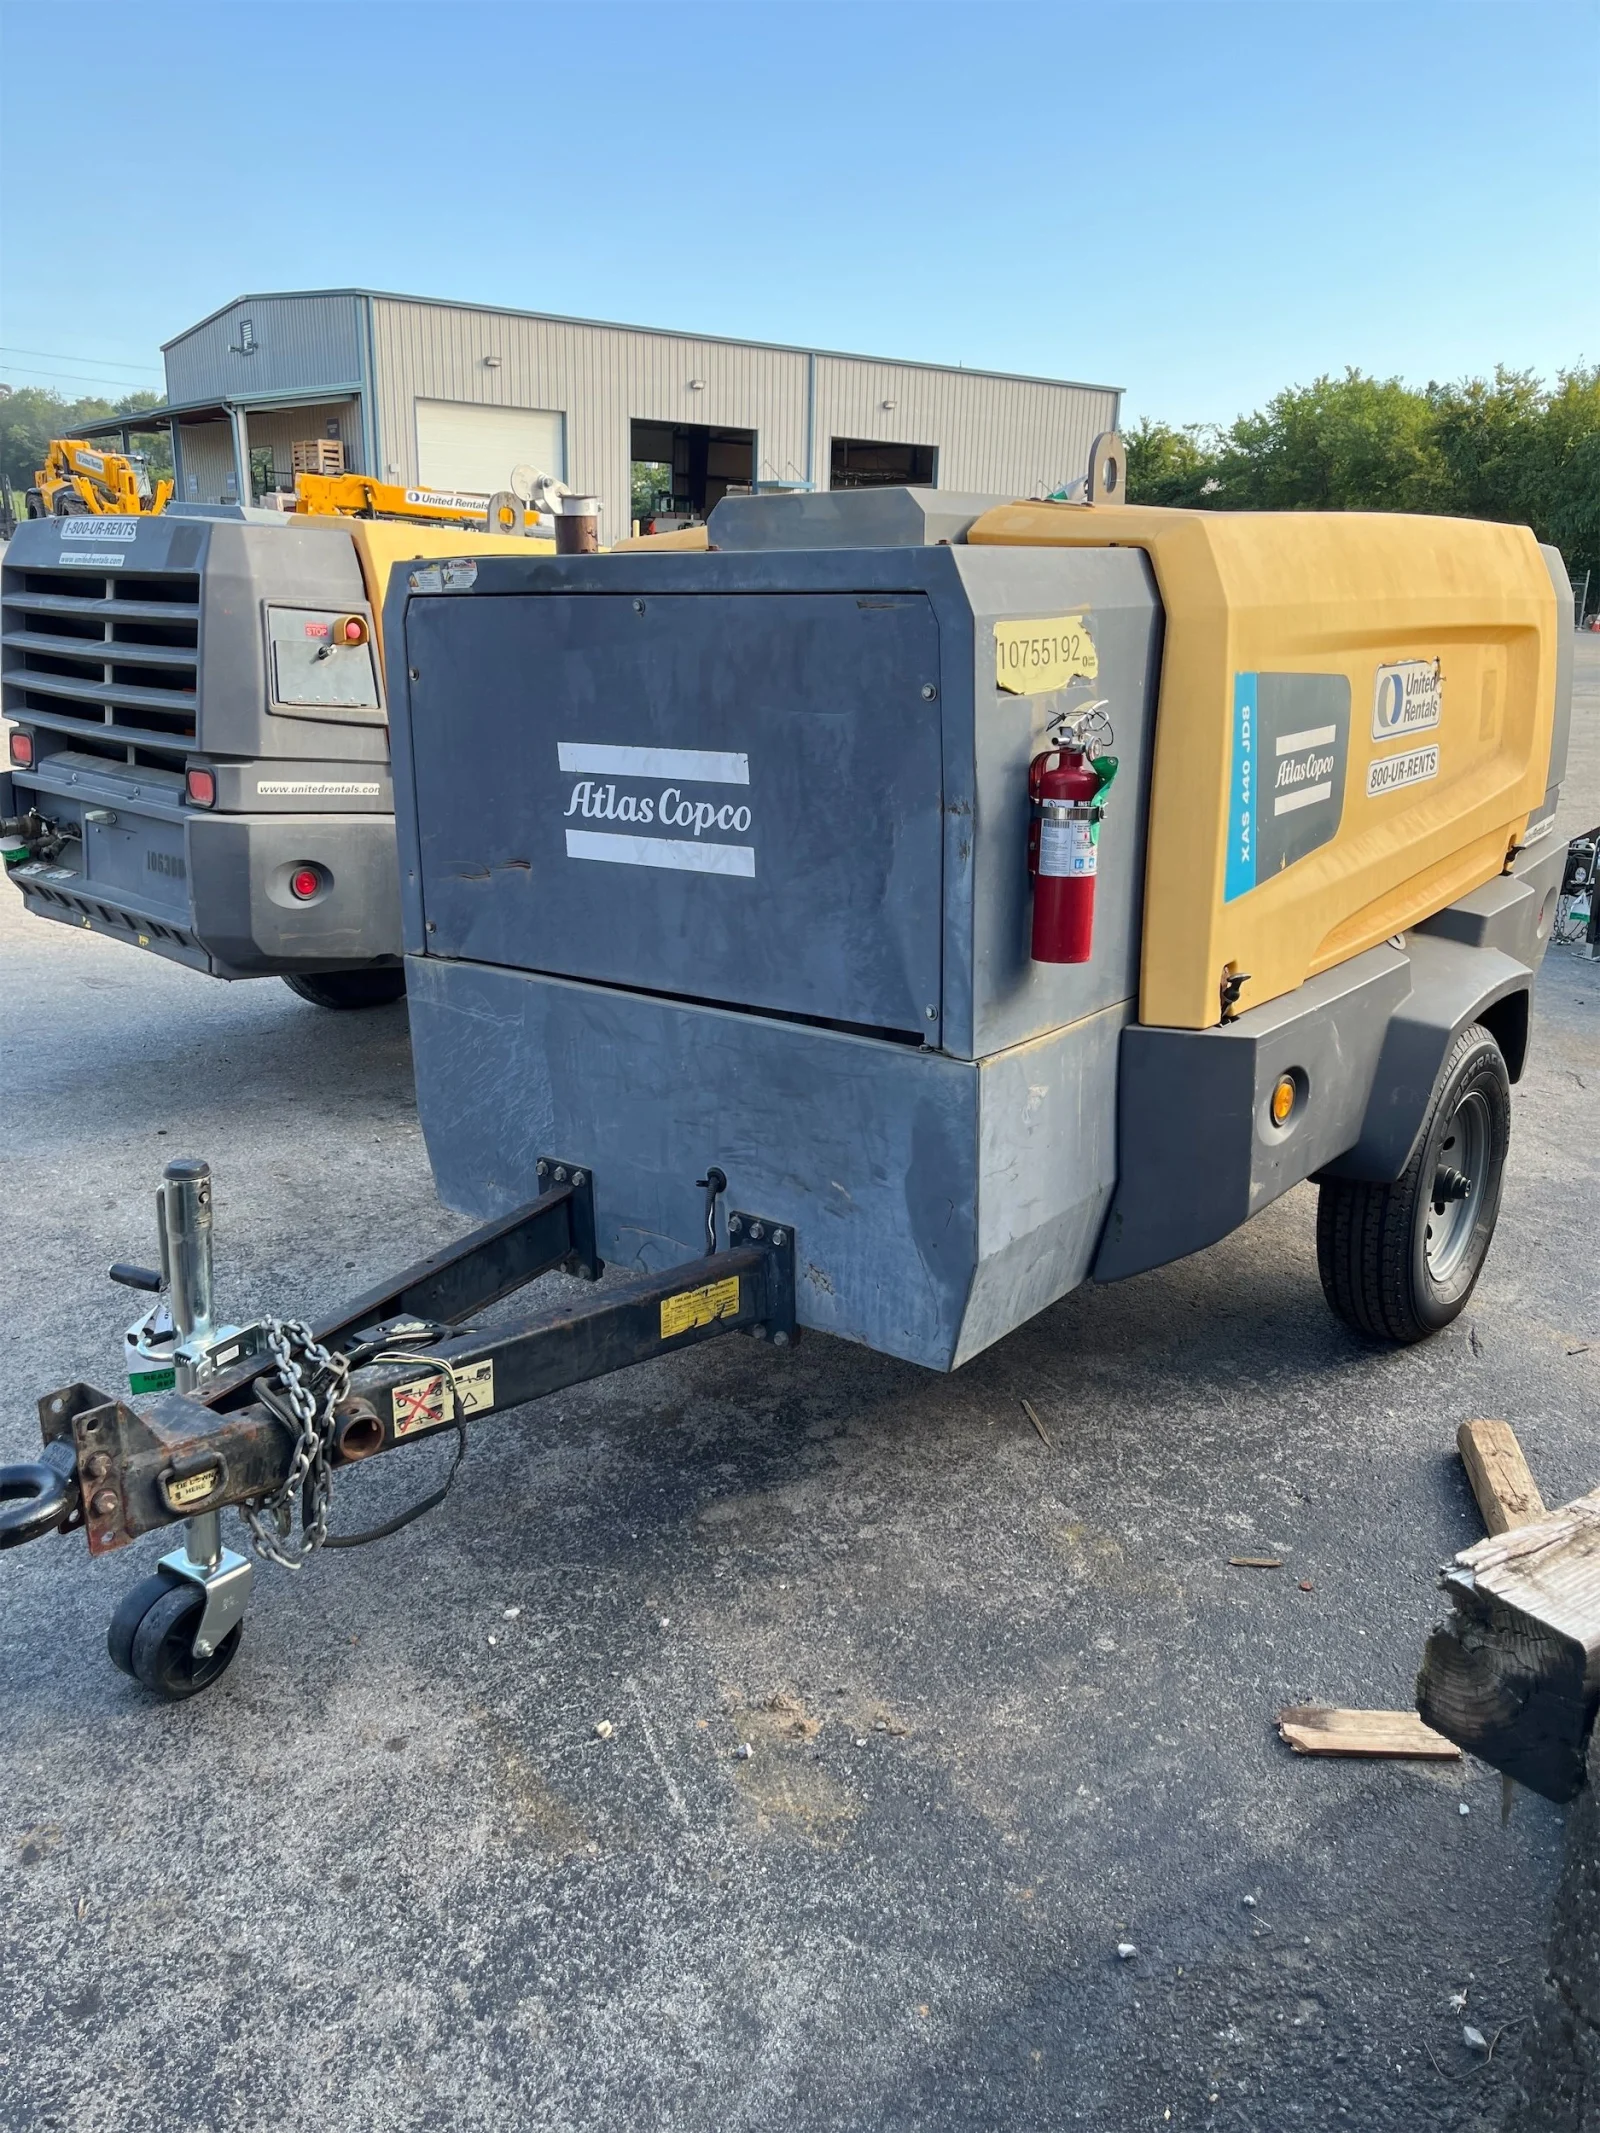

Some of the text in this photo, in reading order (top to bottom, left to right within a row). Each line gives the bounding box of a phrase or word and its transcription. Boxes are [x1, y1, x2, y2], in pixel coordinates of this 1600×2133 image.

[422, 494, 489, 510] United Rentals
[65, 521, 136, 536] 1-800-UR-RENTS
[306, 627, 327, 636] STOP
[999, 634, 1080, 670] 10755192
[1406, 671, 1436, 697] United
[1403, 695, 1438, 723] Rentals
[1370, 751, 1436, 788] 800-UR-RENTS
[1241, 705, 1250, 863] XAS 440 JD8
[564, 781, 752, 836] Atlas Copco
